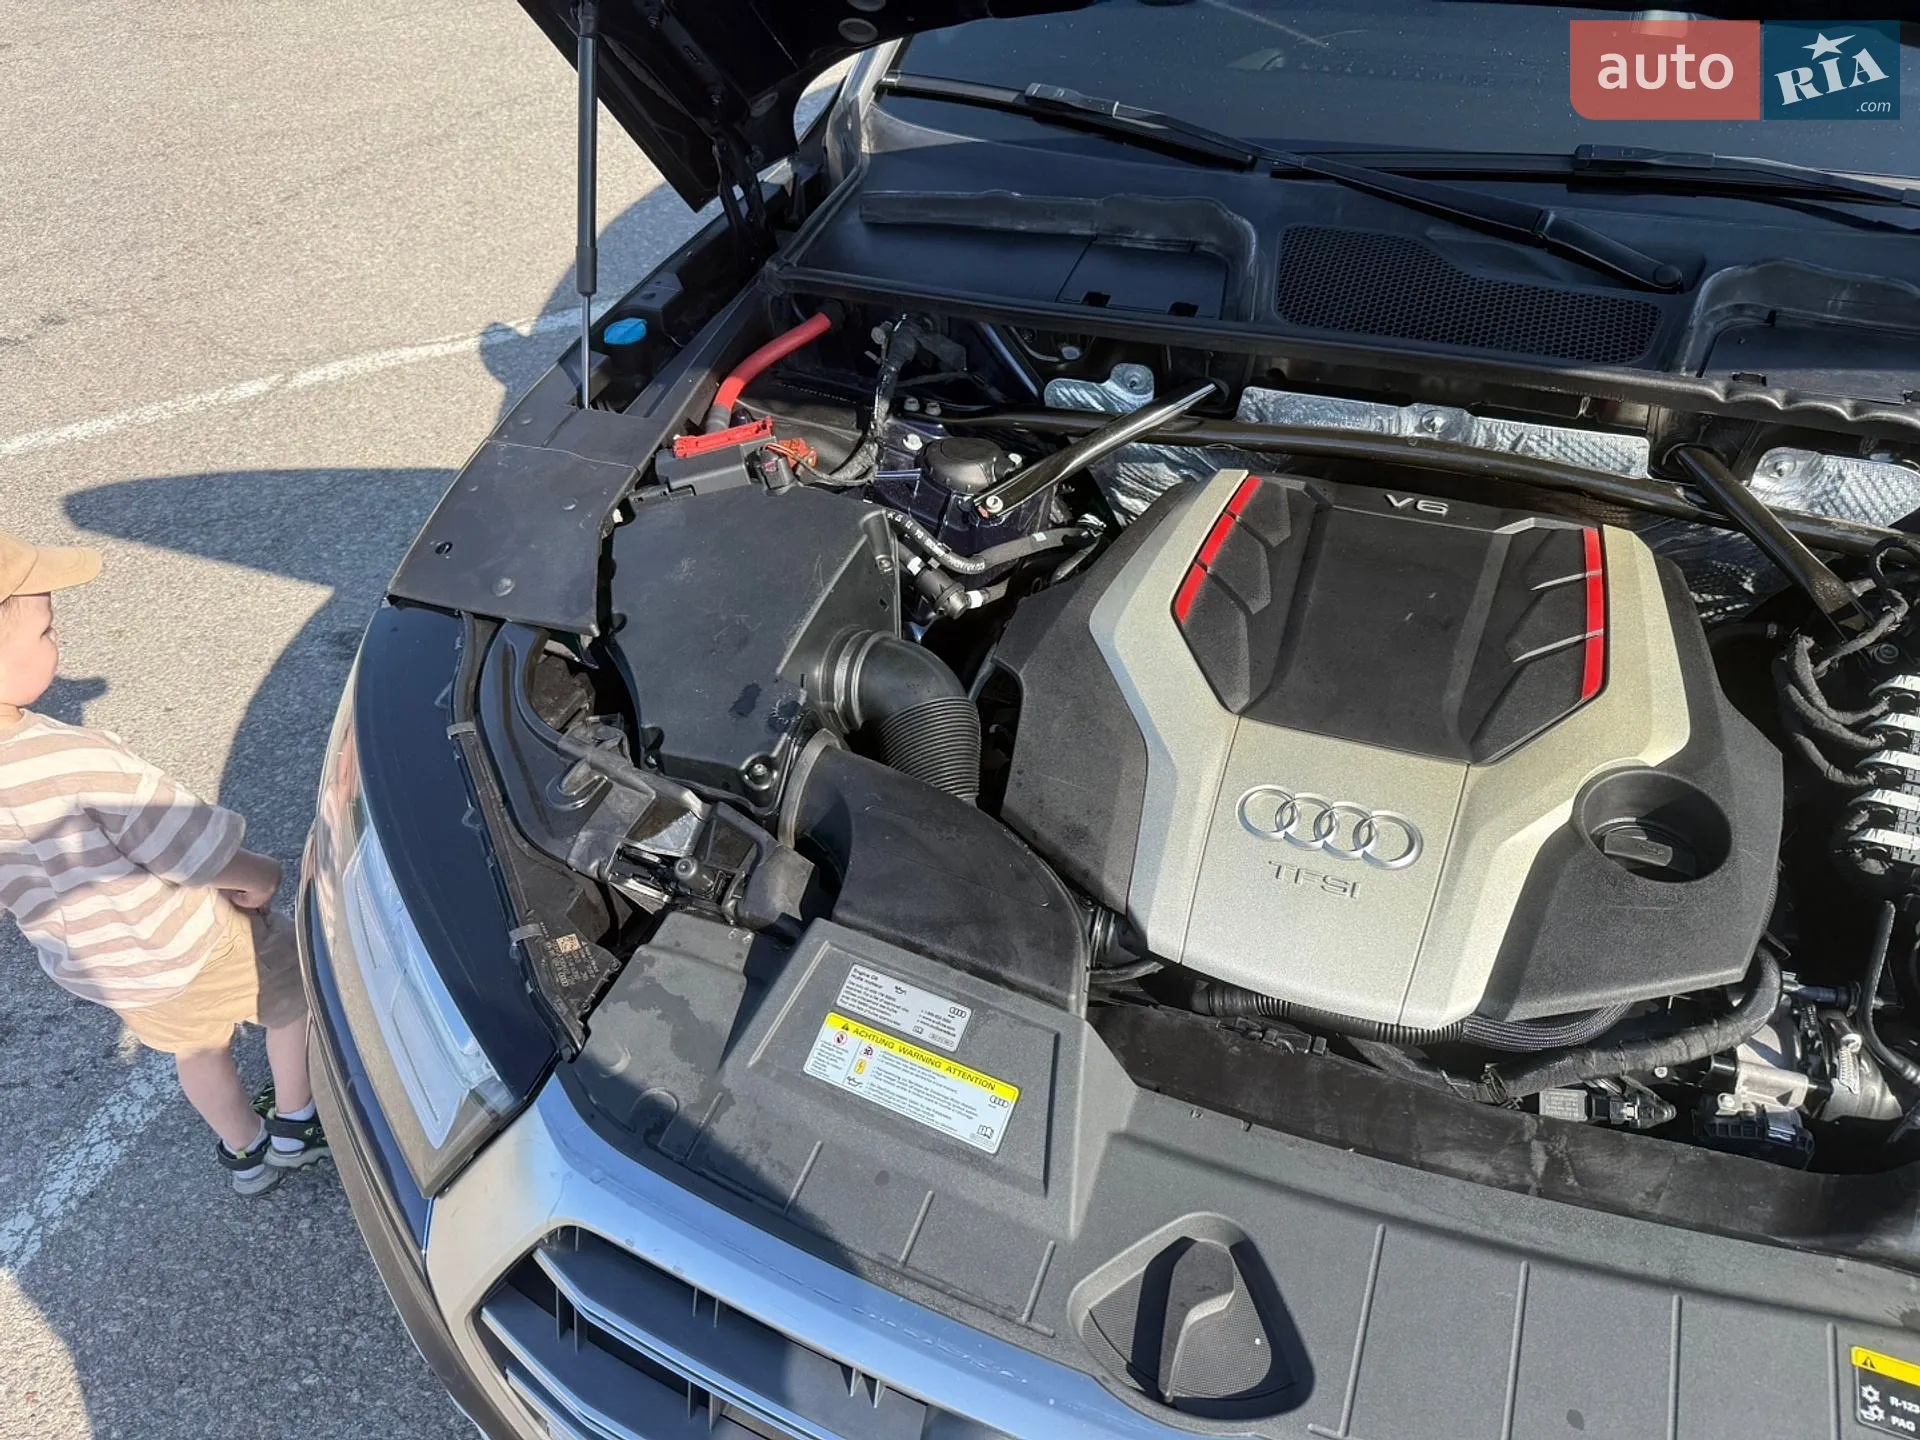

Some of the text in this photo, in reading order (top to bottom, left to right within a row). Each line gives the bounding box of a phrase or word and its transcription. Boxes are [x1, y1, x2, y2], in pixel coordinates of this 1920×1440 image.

[1383, 493, 1449, 517] V6
[1268, 860, 1362, 900] TFSI
[852, 1027, 896, 1050] ACHTUNG
[898, 1045, 942, 1069] WARNING
[945, 1065, 997, 1091] ATTENTION
